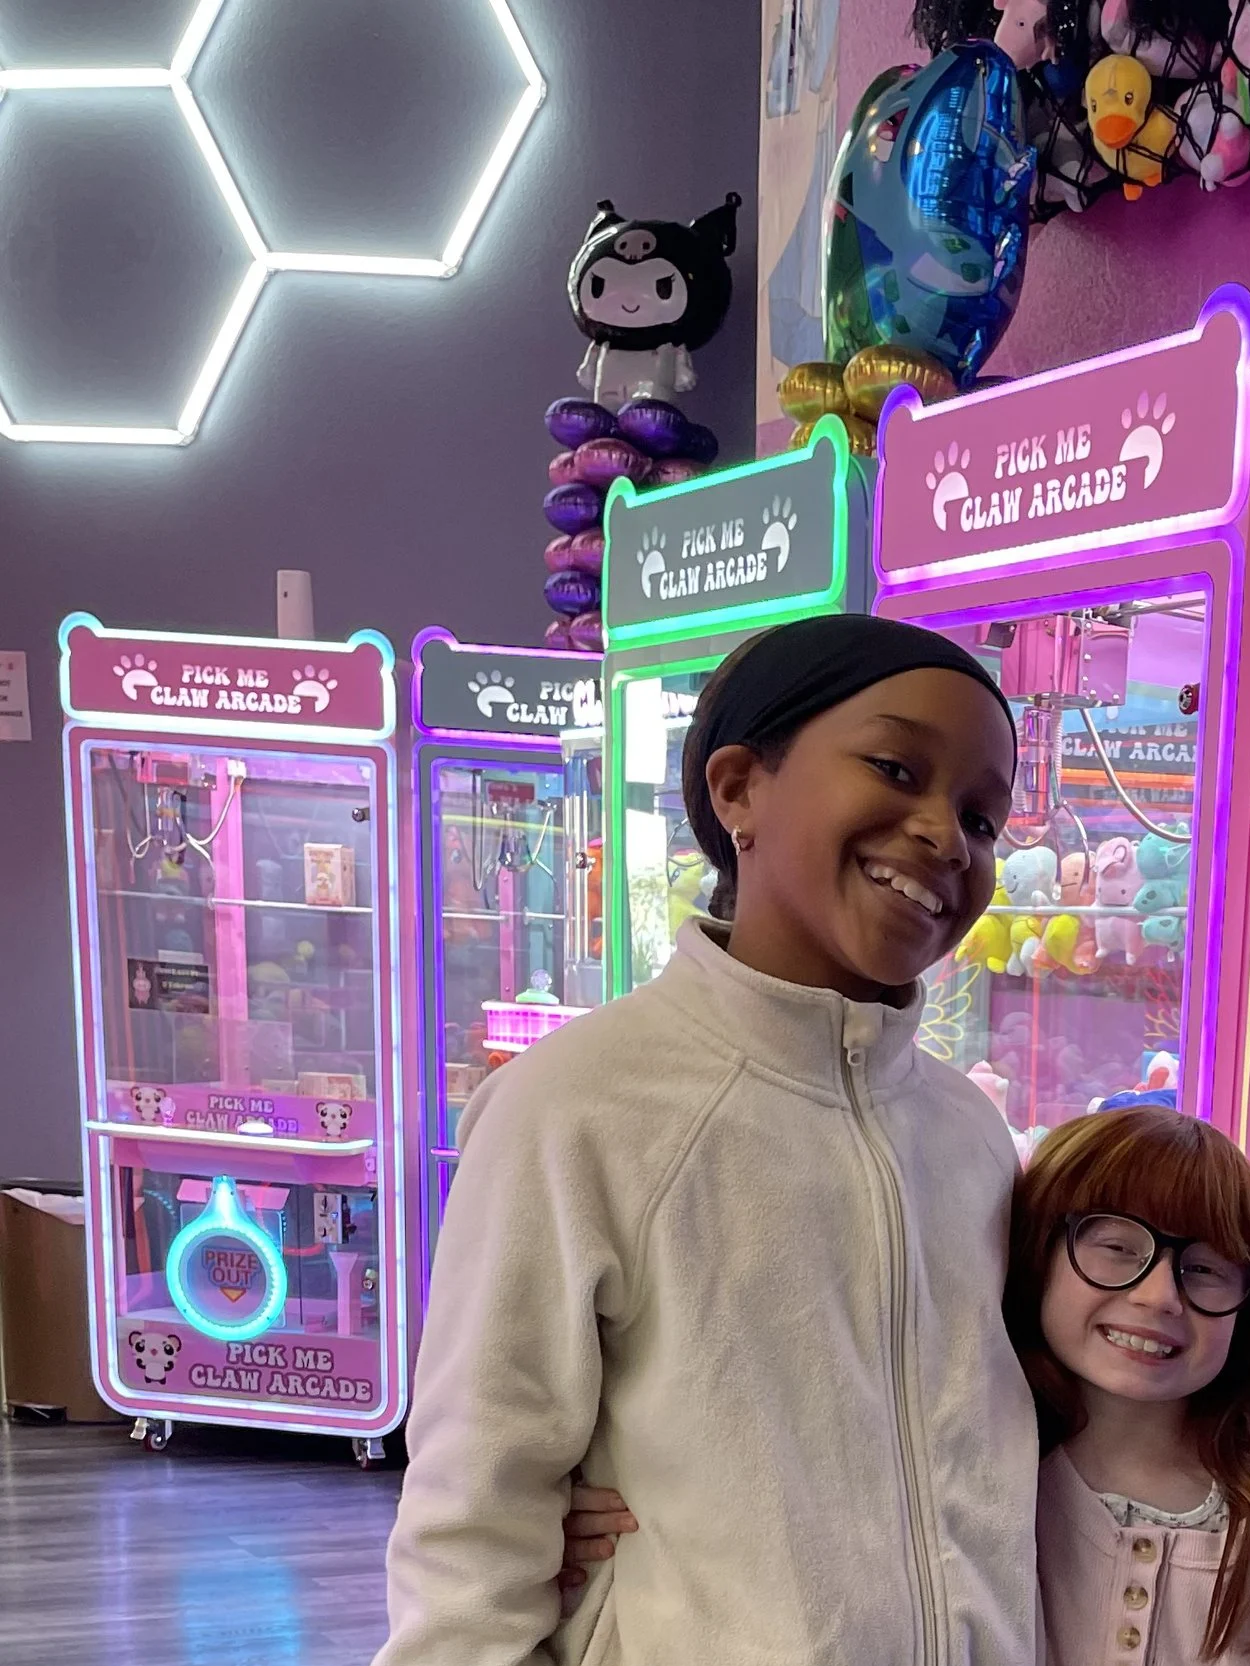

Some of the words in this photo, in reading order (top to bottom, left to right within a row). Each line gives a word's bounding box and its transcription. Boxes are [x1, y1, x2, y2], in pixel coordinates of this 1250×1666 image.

[994, 433, 1048, 480] PICK
[1054, 423, 1092, 466] ME
[960, 486, 1023, 533] CLAW
[1027, 463, 1128, 520] ARCADE
[681, 523, 717, 559] PICK
[720, 517, 745, 551] ME
[659, 565, 701, 601] CLAW
[703, 551, 768, 593] ARCADE
[181, 663, 231, 686] PICK
[236, 668, 270, 689] ME
[150, 685, 210, 709] CLAW
[214, 690, 302, 714] ARCADE
[539, 680, 574, 702] PIC
[506, 702, 569, 726] CLAW
[1128, 741, 1197, 763] ARCA
[208, 1095, 246, 1112] PICK
[249, 1099, 275, 1114] ME
[185, 1110, 230, 1131] CLAW
[204, 1250, 259, 1270] PRIZE
[212, 1267, 253, 1285] OUT
[228, 1342, 287, 1367] PICK
[294, 1348, 333, 1371] ME
[190, 1365, 261, 1392] CLAW
[268, 1373, 372, 1402] ARCADE
